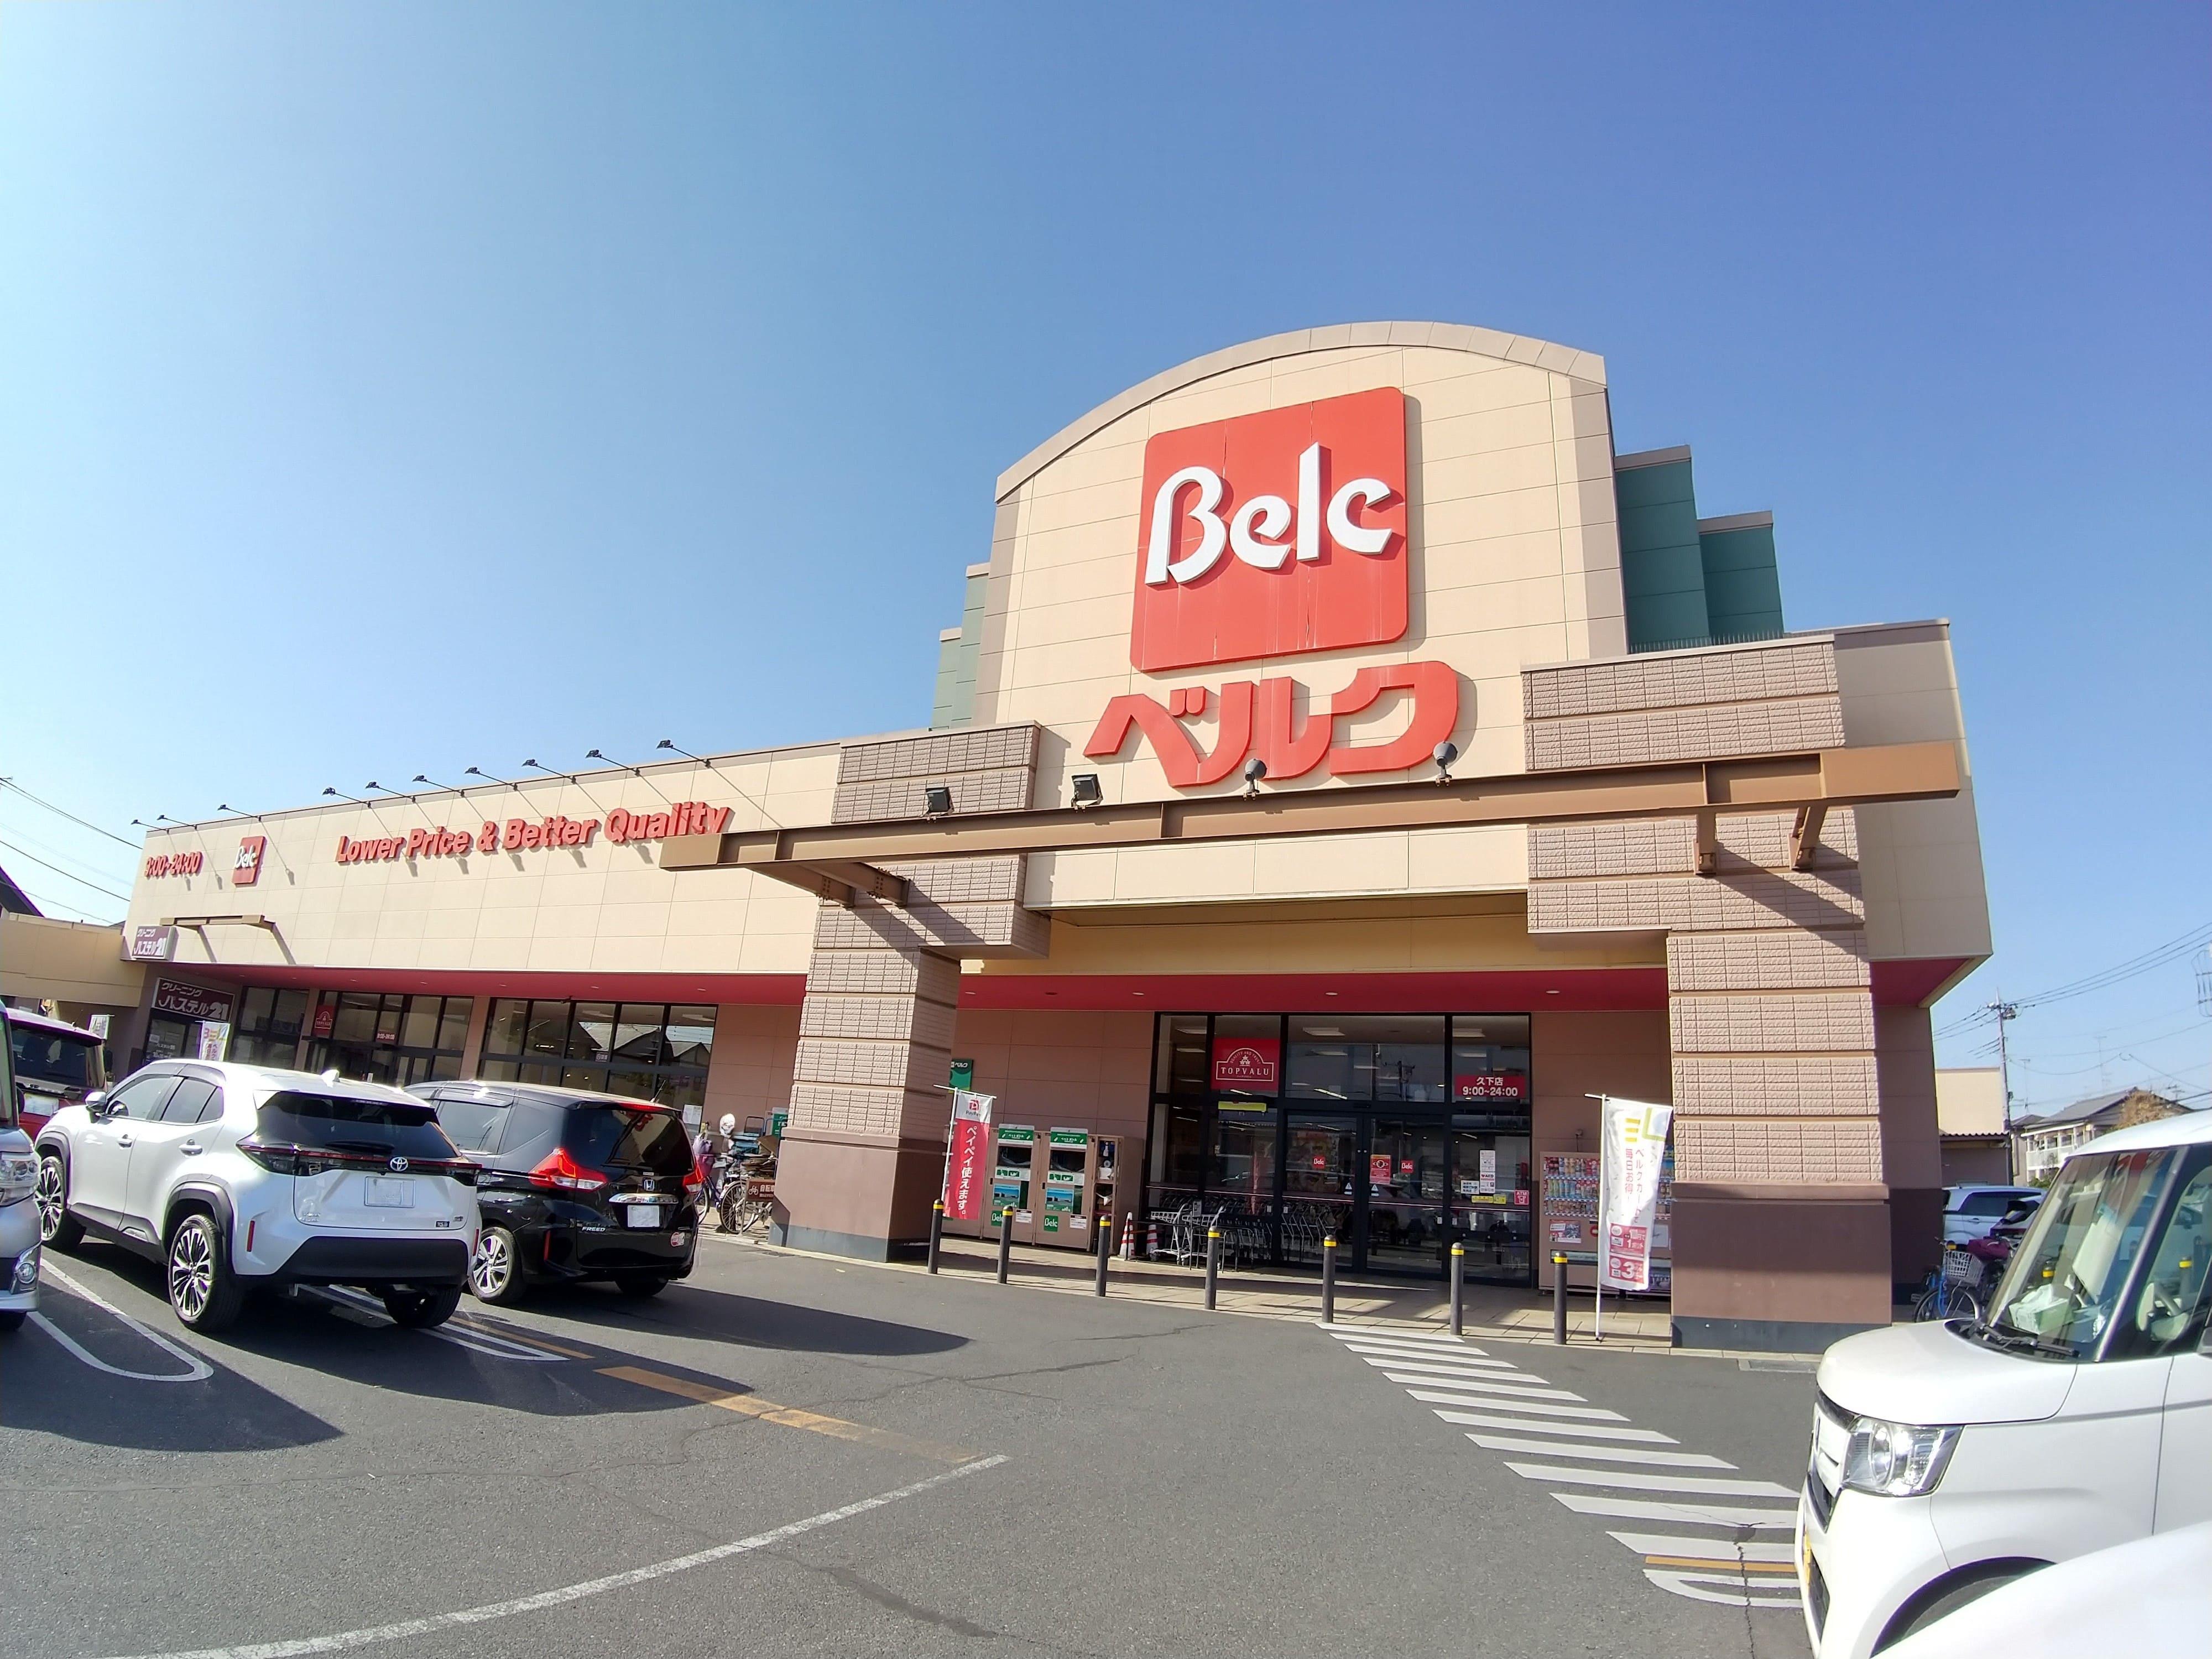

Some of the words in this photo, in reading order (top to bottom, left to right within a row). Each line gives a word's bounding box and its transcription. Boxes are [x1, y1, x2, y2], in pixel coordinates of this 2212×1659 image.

[1144, 441, 1394, 586] Belc
[1083, 660, 1458, 788] ベルク
[337, 836, 406, 865] Lower
[406, 827, 474, 857] Price
[476, 821, 500, 852] &
[502, 816, 601, 850] Better
[604, 801, 735, 841] Quality
[234, 844, 257, 870] Belc
[161, 983, 204, 997] クリーニング
[1220, 1067, 1269, 1076] TOPVALU
[1476, 1076, 1504, 1086] 久下店
[957, 1125, 978, 1215] ペイペイ使えます。
[1044, 1218, 1058, 1227] Belc
